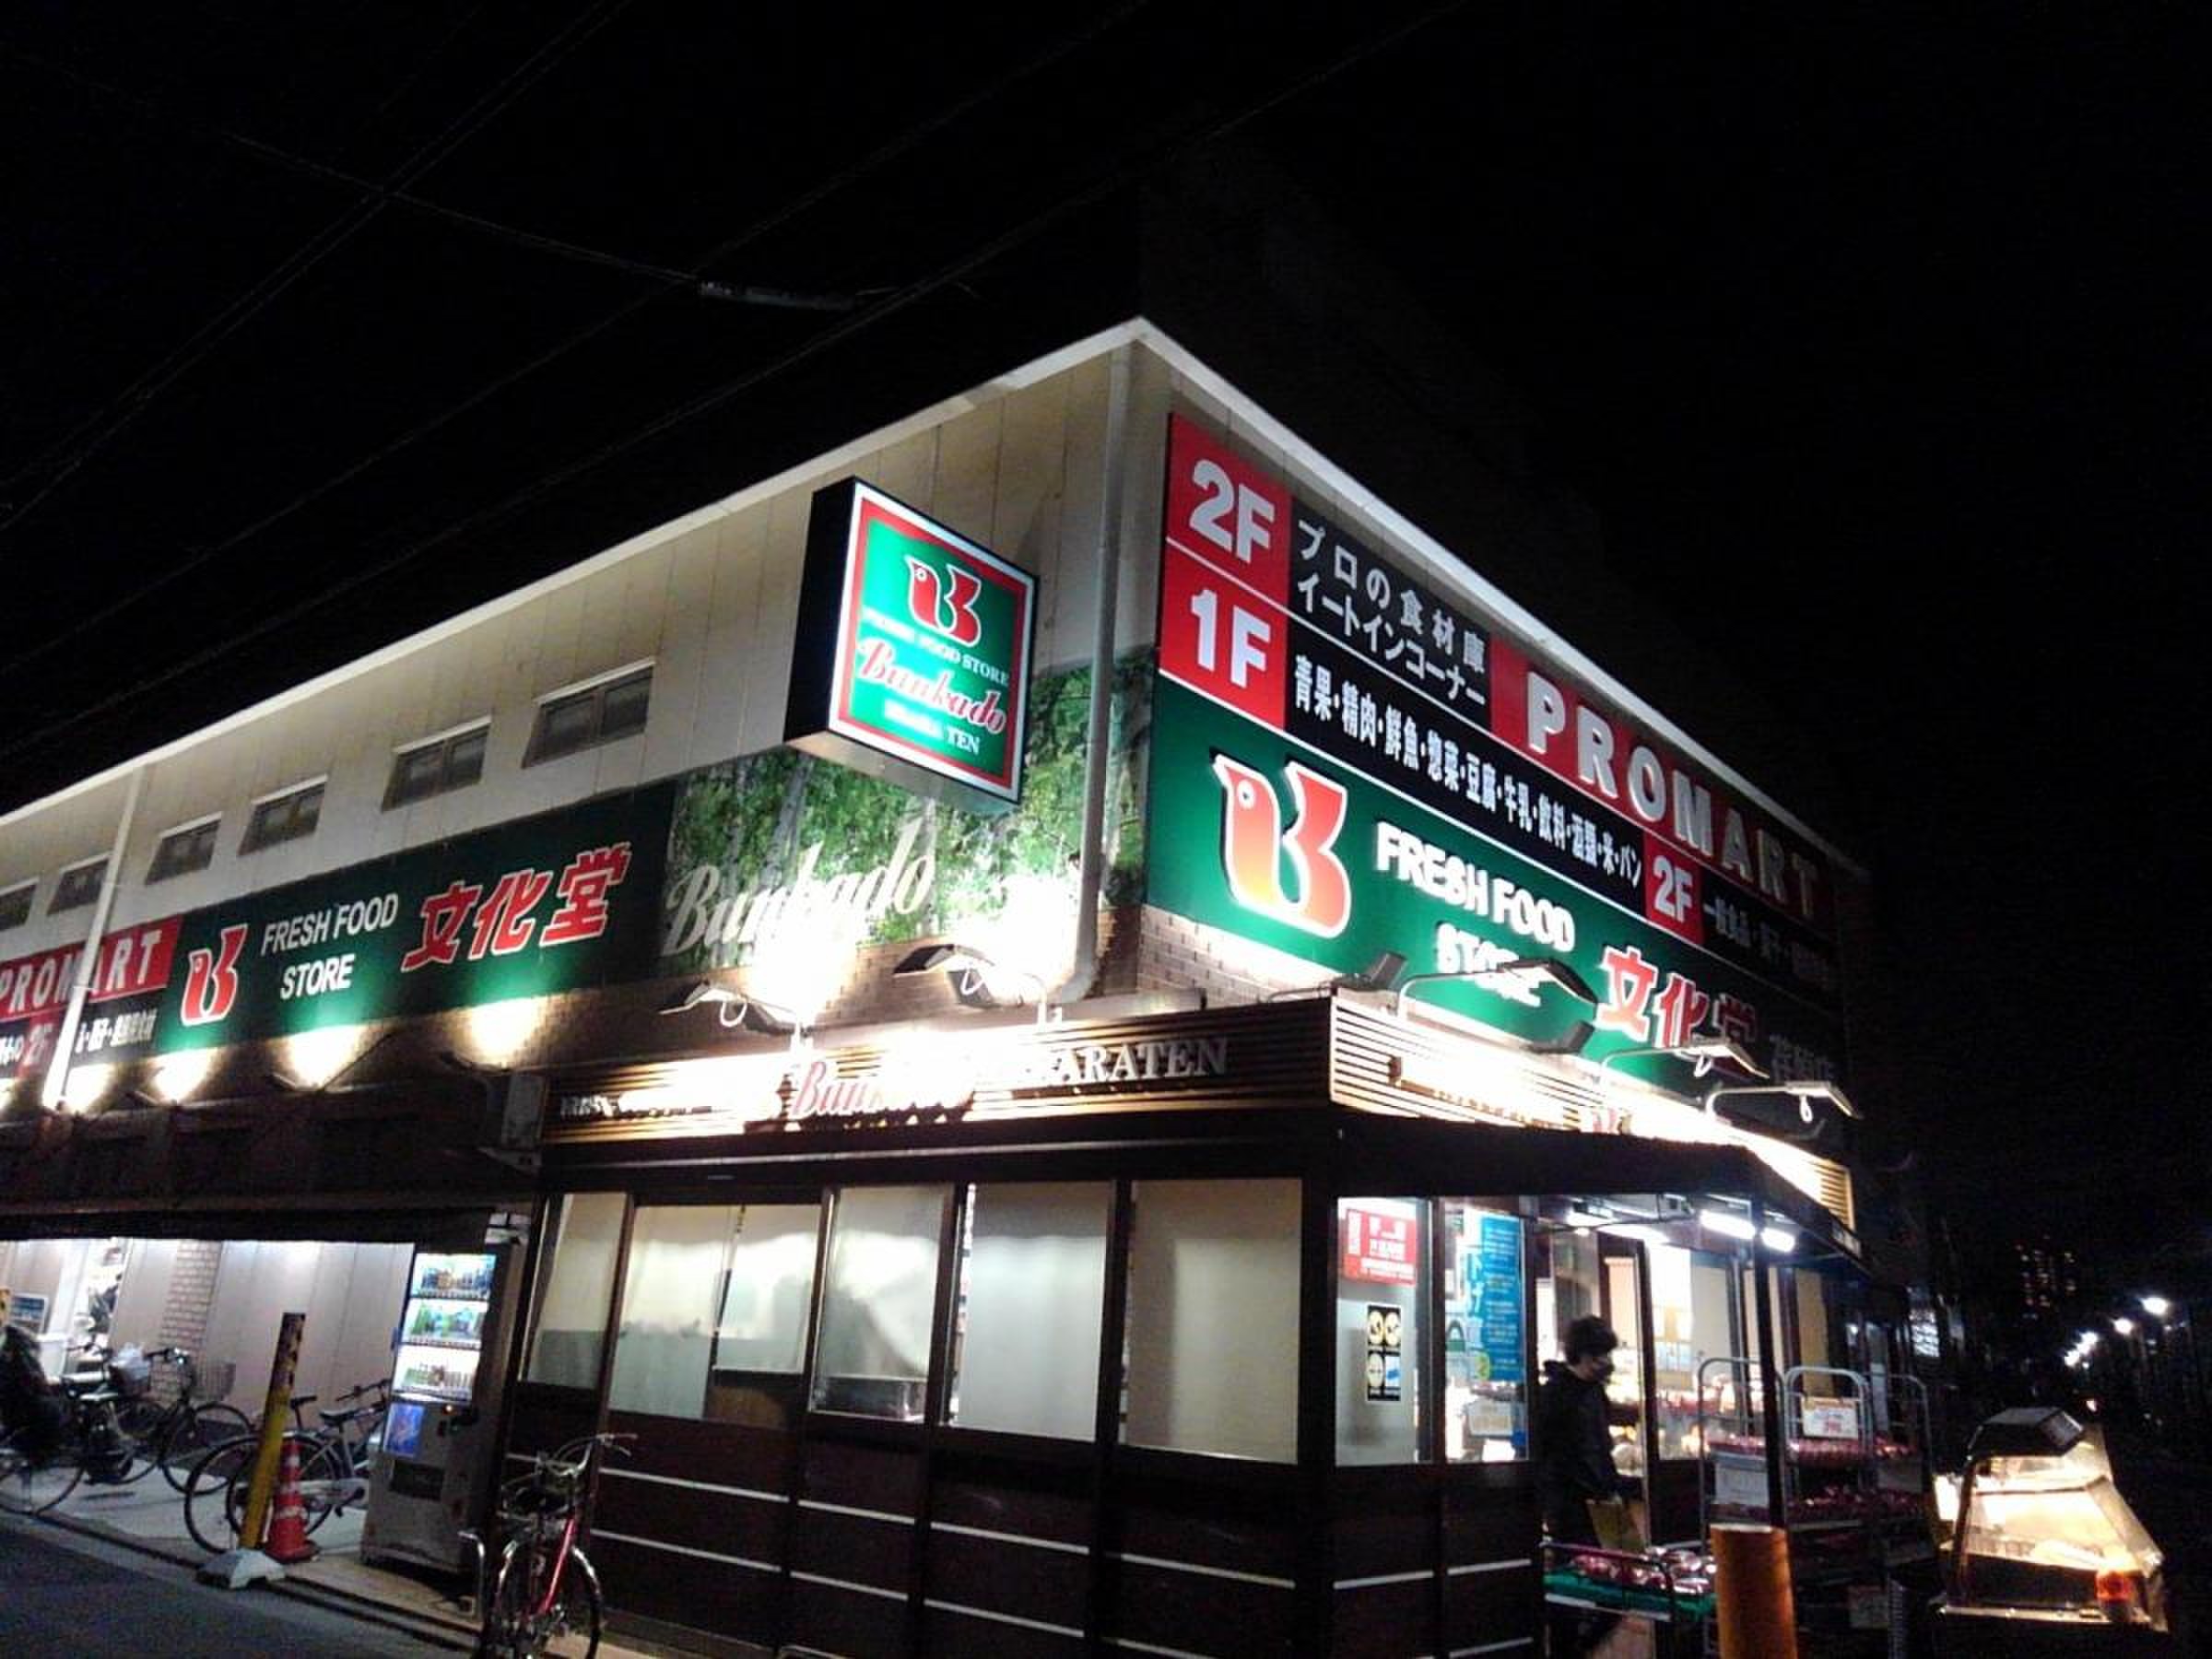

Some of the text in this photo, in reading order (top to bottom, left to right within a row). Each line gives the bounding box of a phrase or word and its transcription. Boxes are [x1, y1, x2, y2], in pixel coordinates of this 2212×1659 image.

[1191, 460, 1275, 565] 2F
[1192, 589, 1271, 689] 1F
[1297, 518, 1487, 676] プロの食材庫
[1297, 572, 1487, 707] イートインコーナー
[857, 636, 1007, 735] Bunkado
[962, 651, 1010, 686] STORE
[946, 724, 981, 755] TEN
[1526, 671, 1818, 917] PROMART
[261, 893, 399, 956] FRESH FOOD
[401, 842, 632, 971] 文化堂
[664, 800, 935, 956] Bunkado
[1377, 822, 1575, 953] FRESH FOOD
[1652, 853, 1694, 925] 2F
[279, 954, 357, 1000] STORE
[1051, 1038, 1229, 1083] ARATEN
